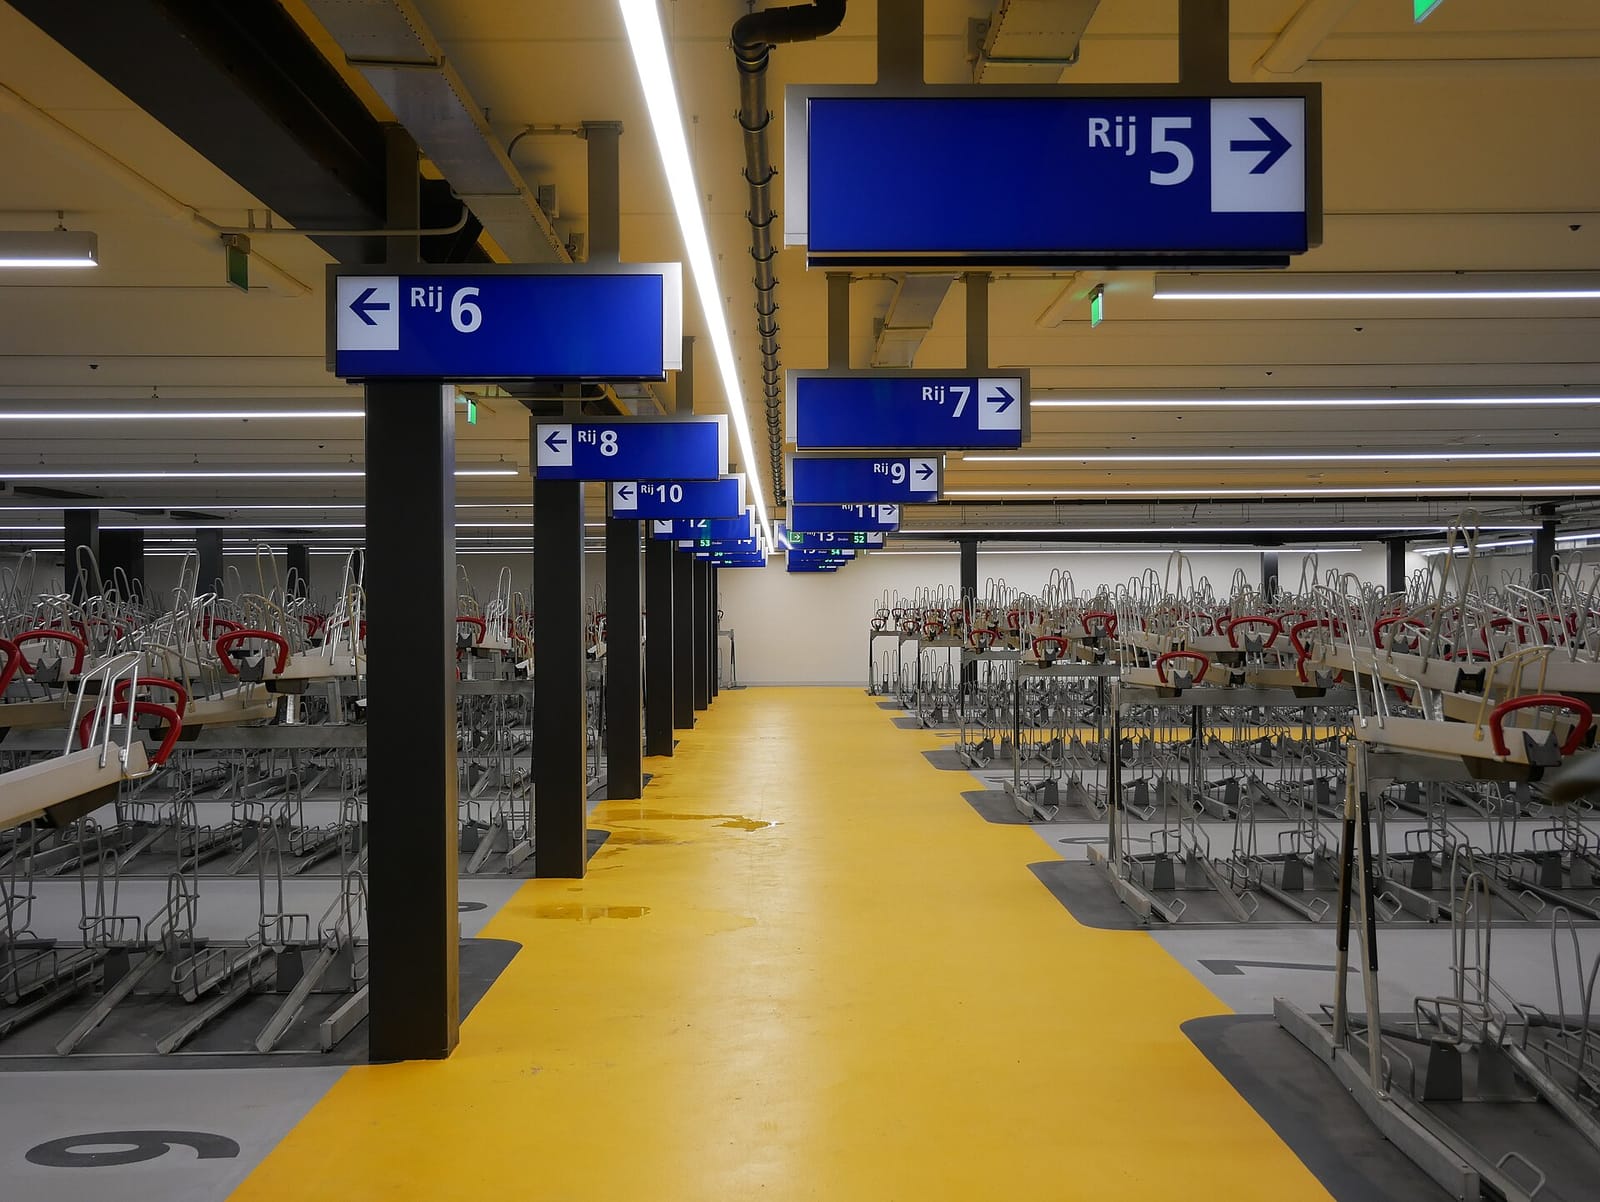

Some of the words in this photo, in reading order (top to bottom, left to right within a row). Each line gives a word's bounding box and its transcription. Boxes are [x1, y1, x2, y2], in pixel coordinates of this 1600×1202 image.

[1088, 115, 1137, 156] Rij
[1149, 116, 1195, 186] 5
[410, 286, 443, 313] Rij
[450, 286, 483, 333] 6
[921, 385, 945, 405] Rij
[949, 386, 971, 418] 7
[577, 430, 597, 445] Rij
[599, 430, 619, 457] 8
[873, 463, 889, 476] Rij
[890, 462, 906, 485] 9
[640, 484, 654, 495] Rij
[656, 484, 683, 503] 10
[855, 504, 876, 518] 11
[24, 1130, 241, 1168] 6
